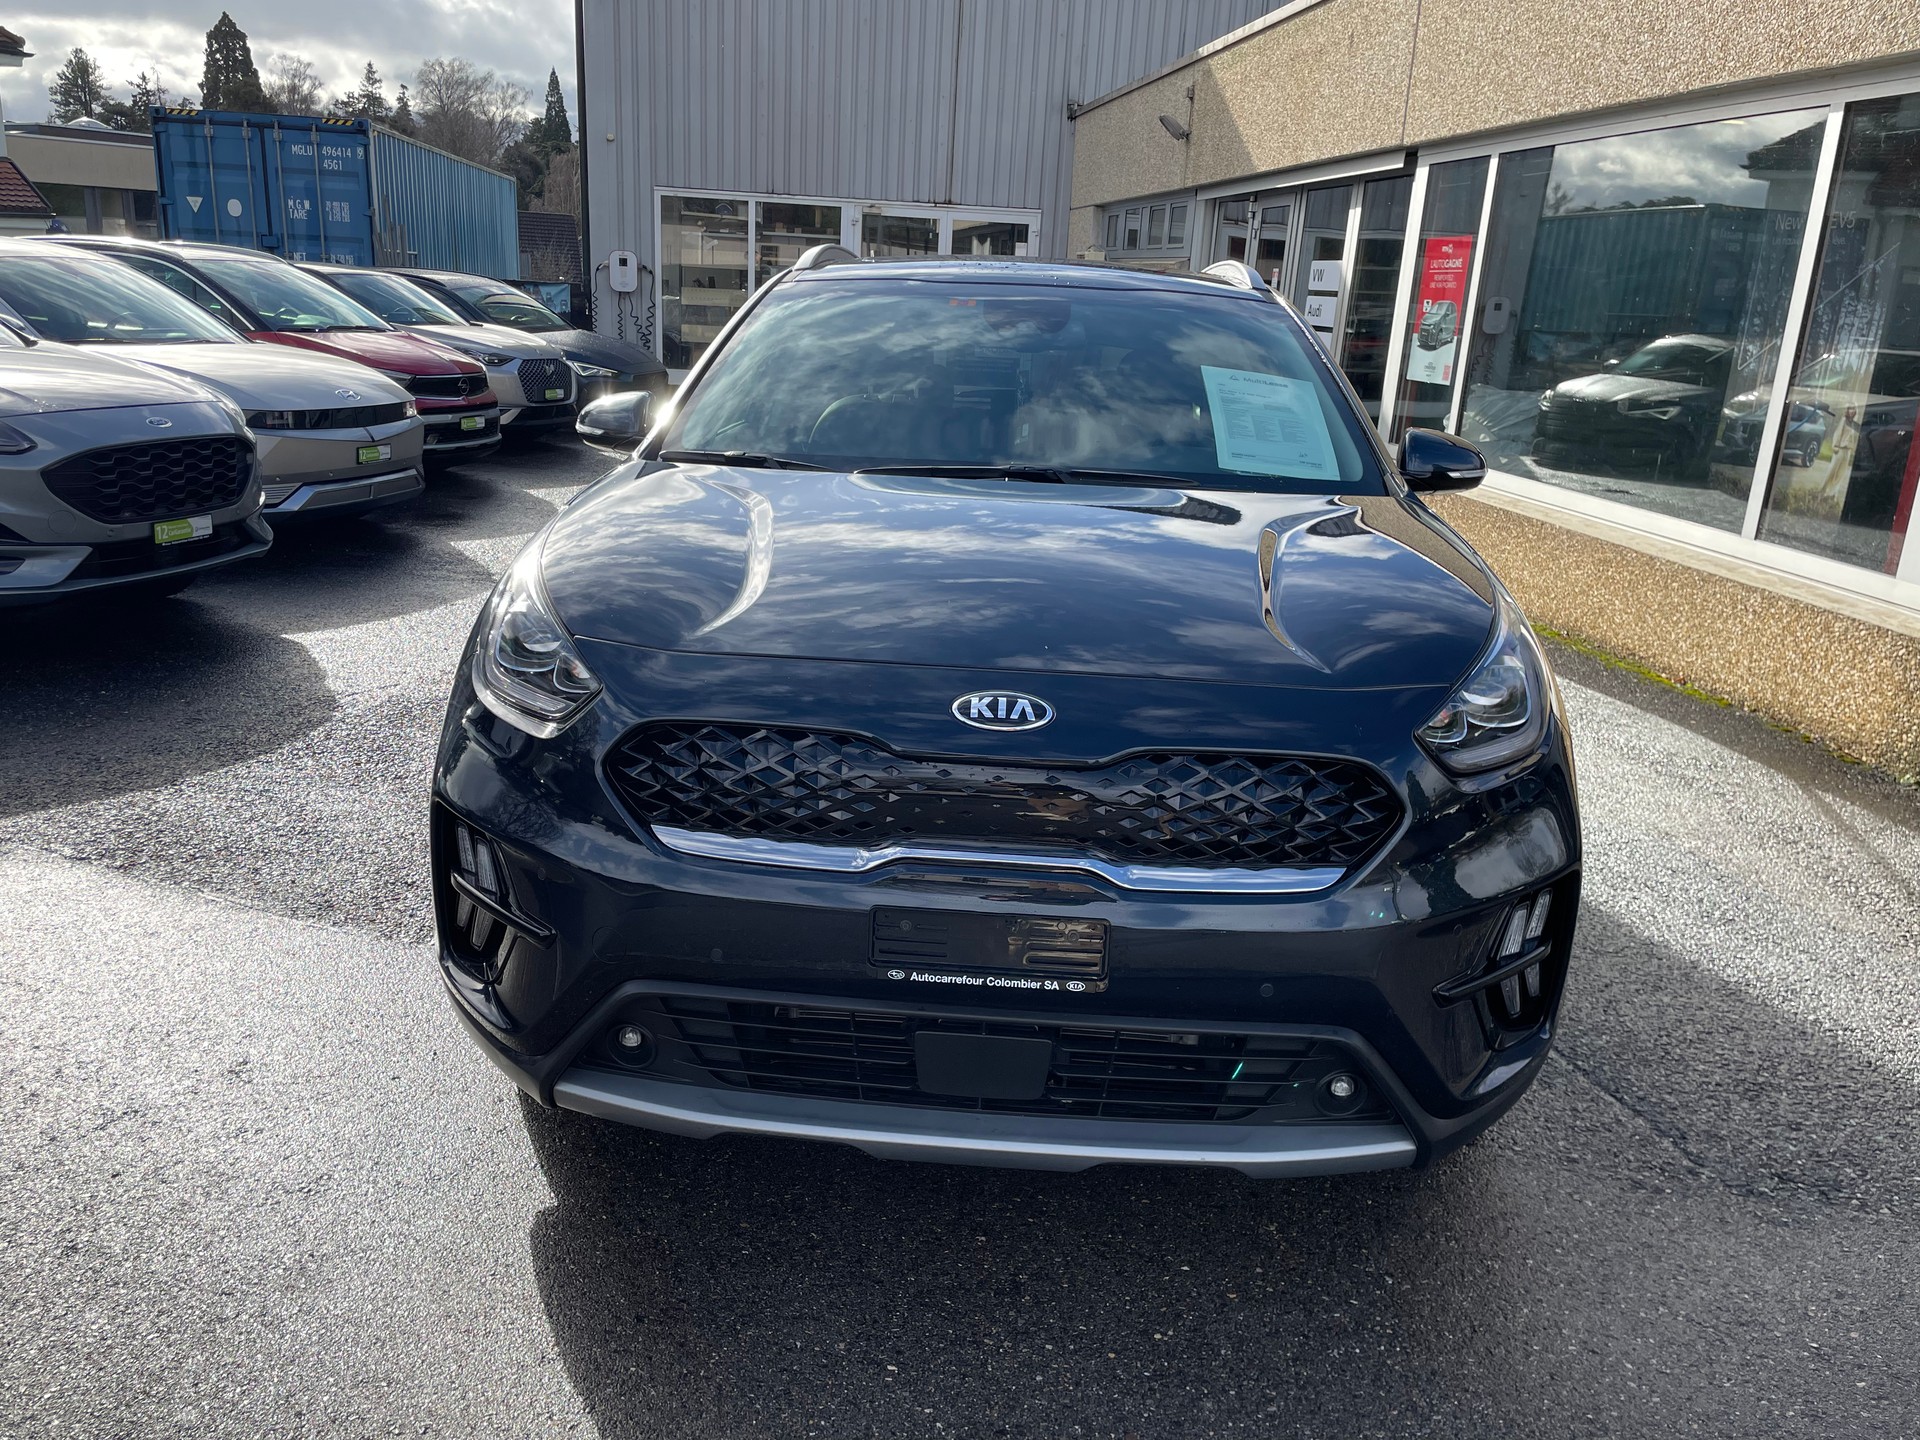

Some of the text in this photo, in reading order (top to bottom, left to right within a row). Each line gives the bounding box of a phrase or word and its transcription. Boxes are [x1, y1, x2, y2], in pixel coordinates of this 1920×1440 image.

[292, 144, 312, 156] MGLU
[322, 146, 351, 158] 496414
[323, 160, 342, 170] 45G1
[289, 208, 308, 220] TARE
[1775, 211, 1857, 231] New EV5
[1313, 269, 1325, 282] VW
[1307, 304, 1322, 317] Audi
[156, 526, 168, 540] 12
[970, 696, 1036, 720] KIA
[910, 972, 984, 986] Autocarrefour
[986, 976, 1042, 989] Colombier
[1044, 980, 1060, 990] SA
